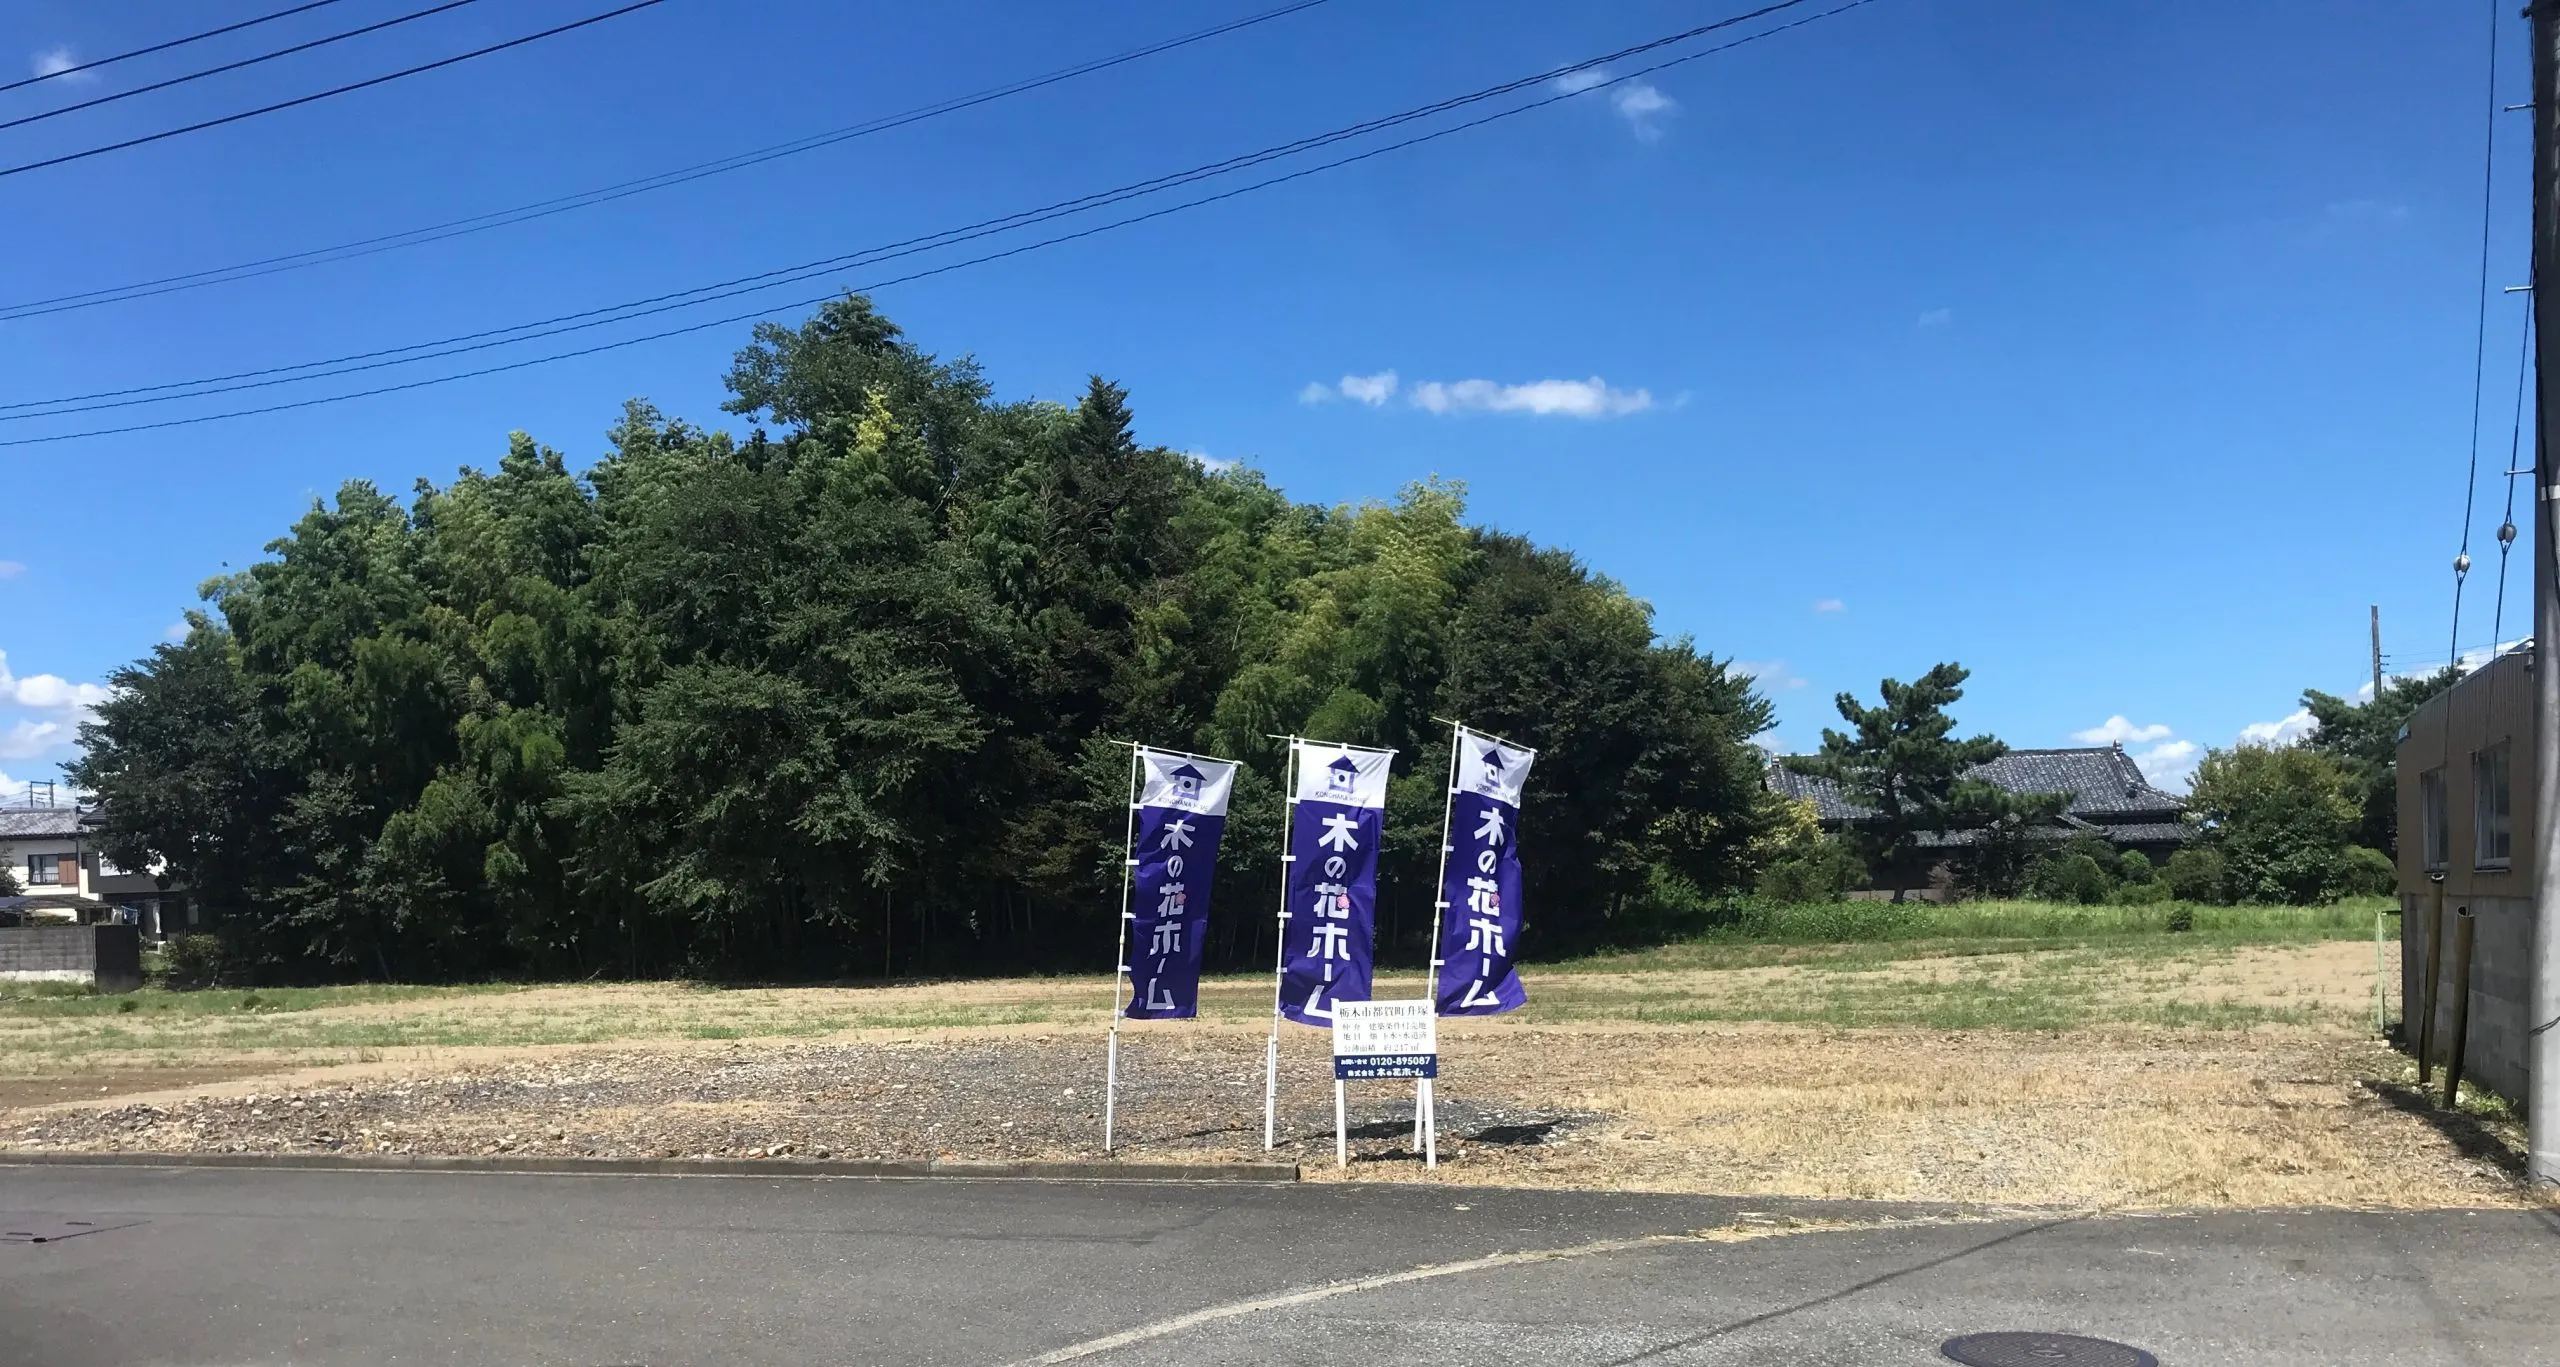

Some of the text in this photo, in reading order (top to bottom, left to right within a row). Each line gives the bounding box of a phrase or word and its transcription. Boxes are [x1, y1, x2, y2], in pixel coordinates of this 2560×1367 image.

[1146, 819, 1196, 1011] 木の花ホーム
[1303, 813, 1359, 1018] 木の花ホーム
[1460, 807, 1507, 1008] 木の花ホーム
[1370, 1056, 1430, 1066] 0120-895087
